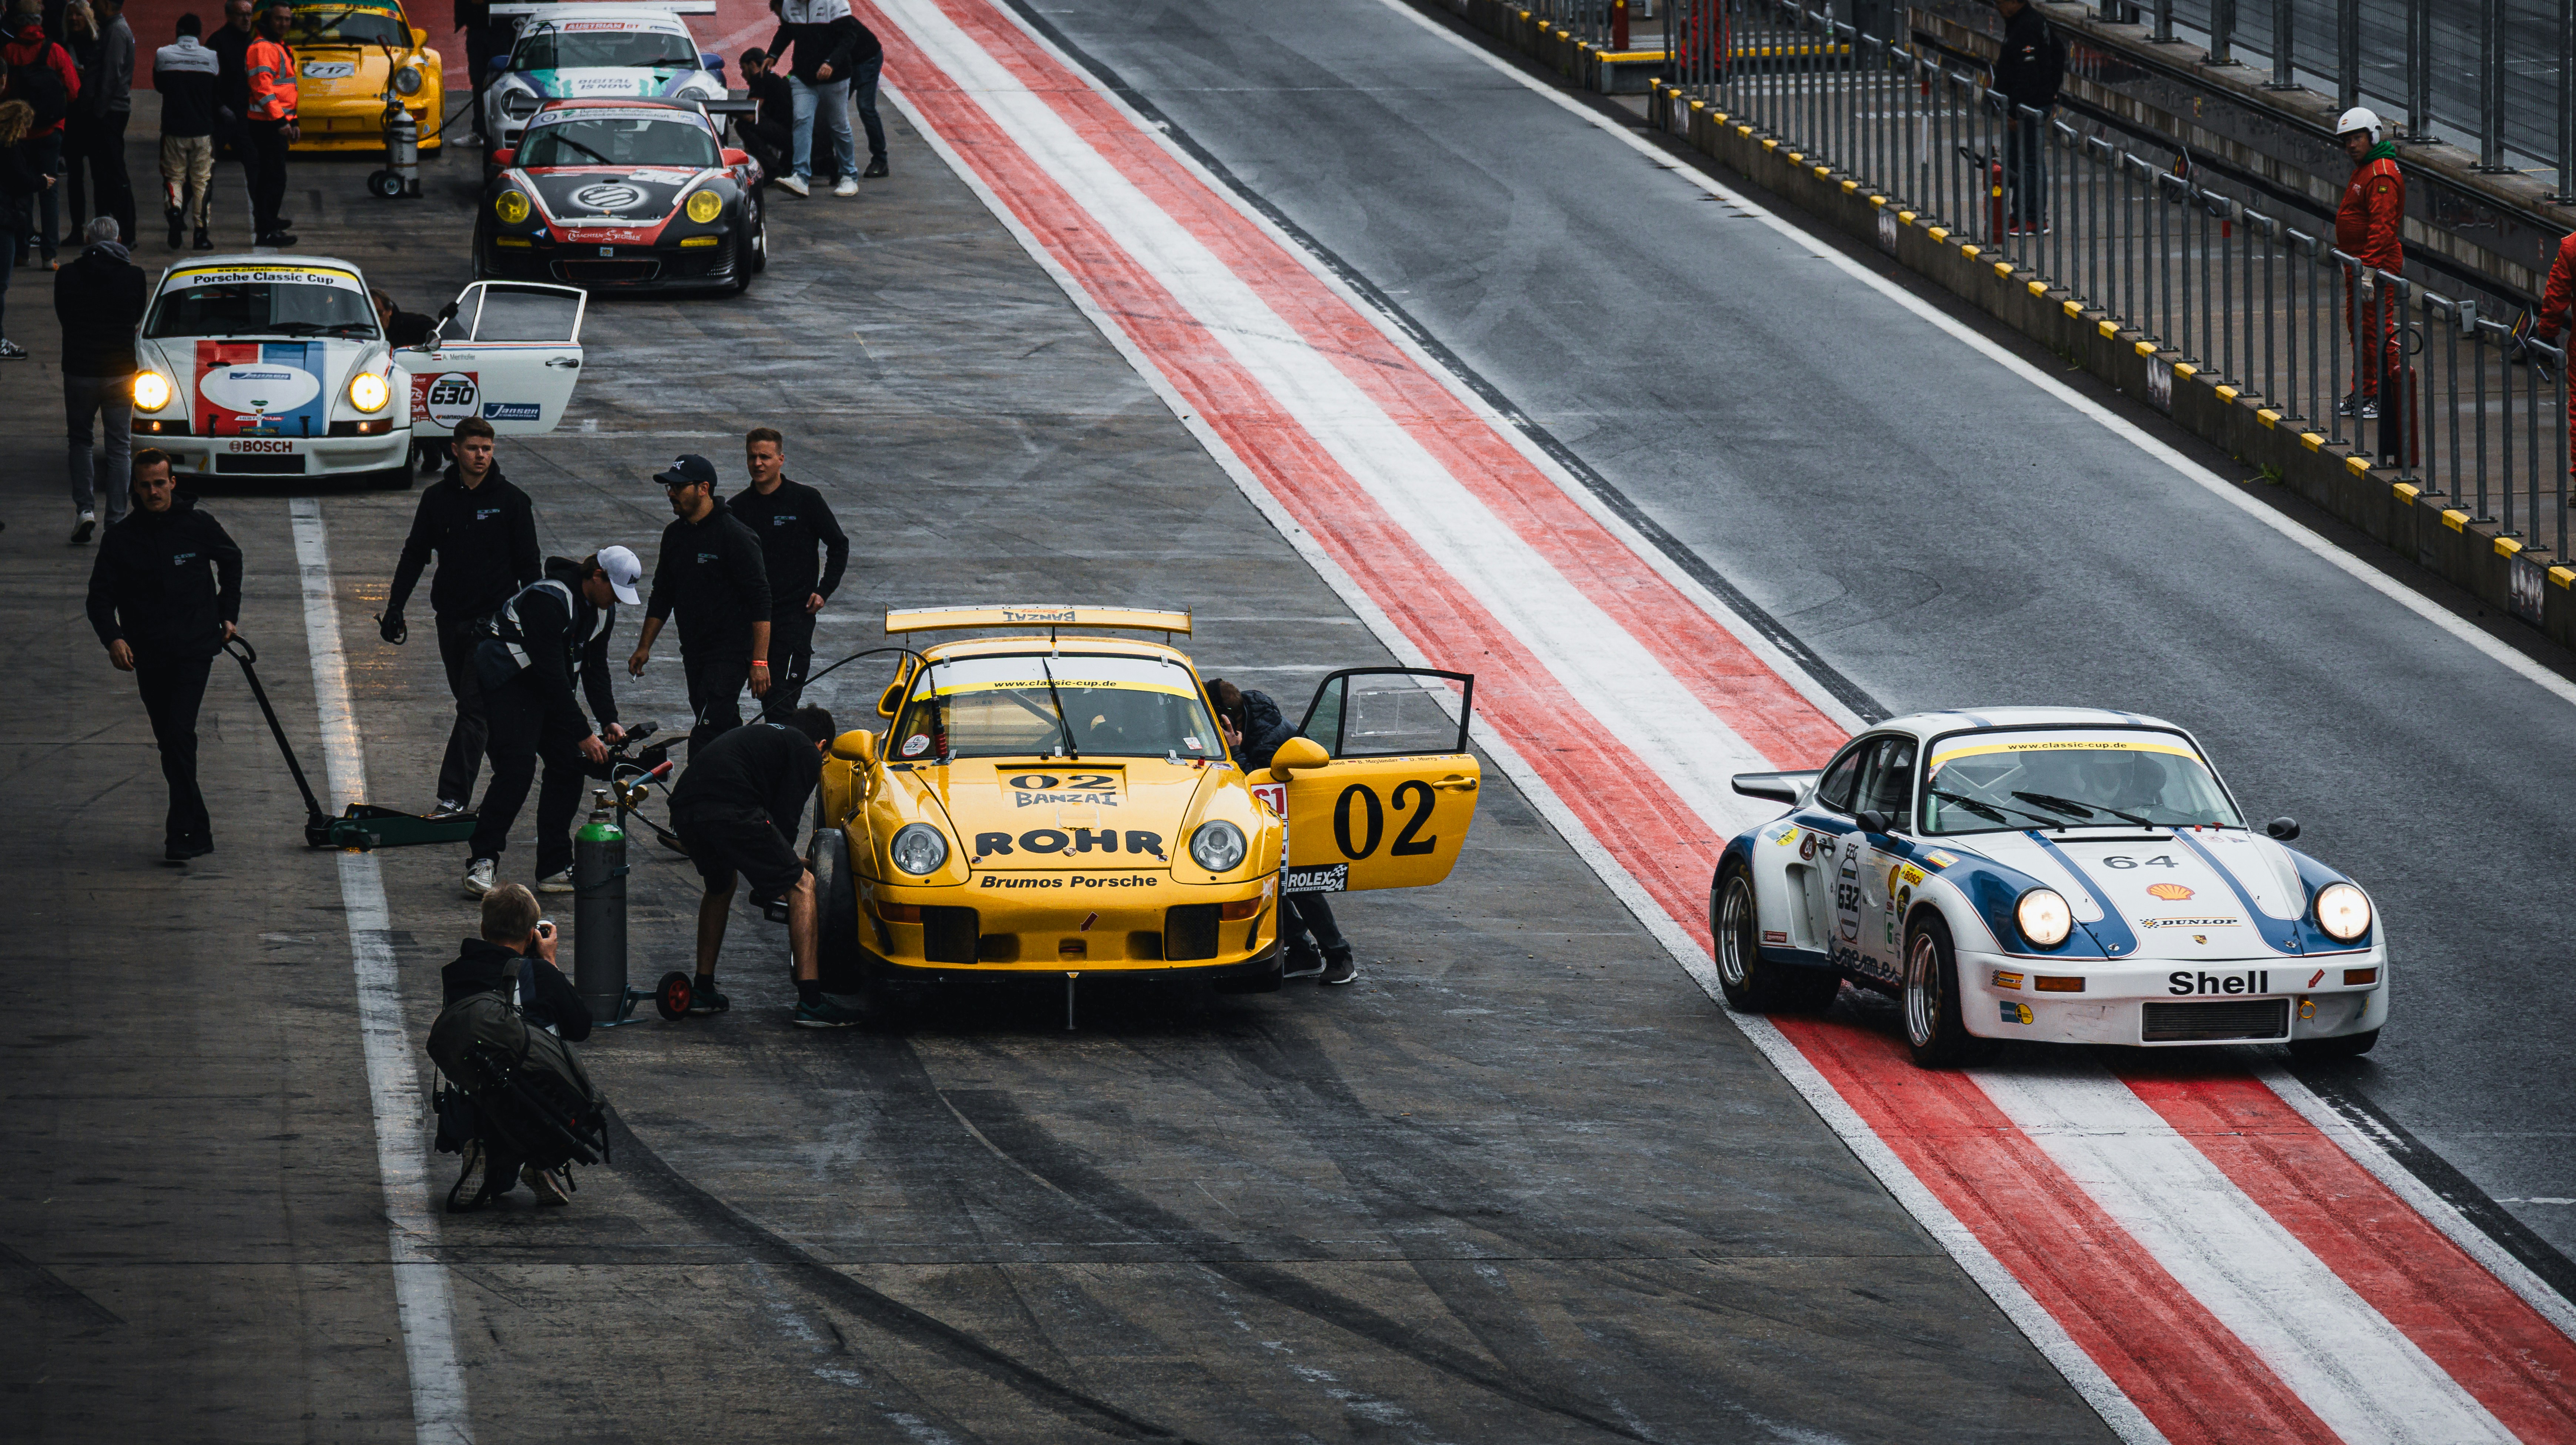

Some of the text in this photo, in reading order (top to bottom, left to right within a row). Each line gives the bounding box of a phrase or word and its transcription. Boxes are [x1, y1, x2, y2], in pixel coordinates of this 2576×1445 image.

[194, 272, 333, 285] Porsche Classic Cup
[430, 387, 474, 405] 630
[485, 405, 539, 418] Jansen
[242, 440, 292, 453] BOSCH
[1003, 611, 1075, 622] BANZAI
[1010, 775, 1117, 789] 02
[1015, 791, 1117, 808] BANZAI
[1334, 780, 1436, 860] 02
[975, 829, 1163, 856] ROHR
[2103, 856, 2178, 869] 64
[980, 875, 1157, 888] Brumos Porsche
[1288, 871, 1333, 888] ROLEX
[1904, 870, 1923, 886] BOSCH
[1838, 884, 1859, 913] 632
[2161, 918, 2238, 926] DUNLOP
[2169, 970, 2268, 995] Shell
